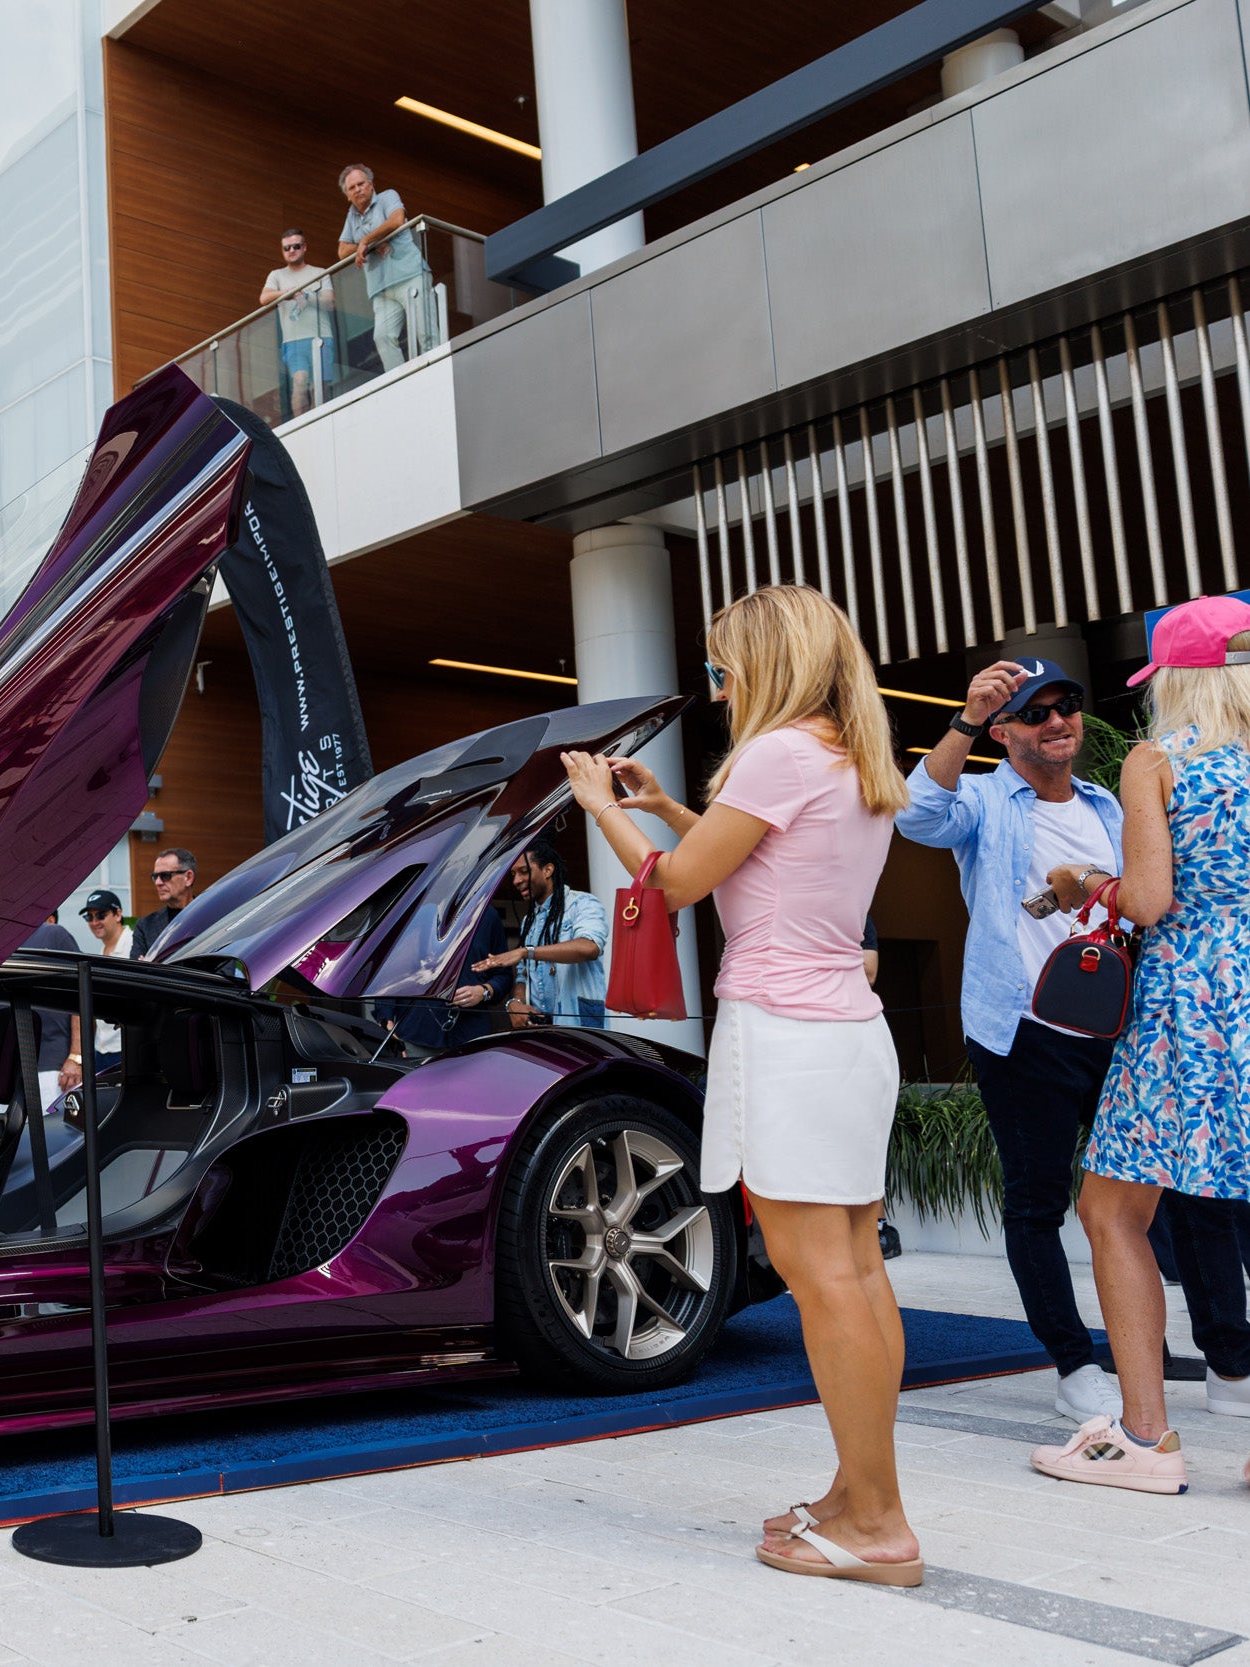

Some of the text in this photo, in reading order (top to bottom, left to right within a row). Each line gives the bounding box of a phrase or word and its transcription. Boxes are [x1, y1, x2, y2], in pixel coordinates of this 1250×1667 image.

[244, 500, 310, 732] WWW.PRESTIGEIMPOR
[280, 750, 347, 831] tige
[332, 733, 347, 787] EST 1977
